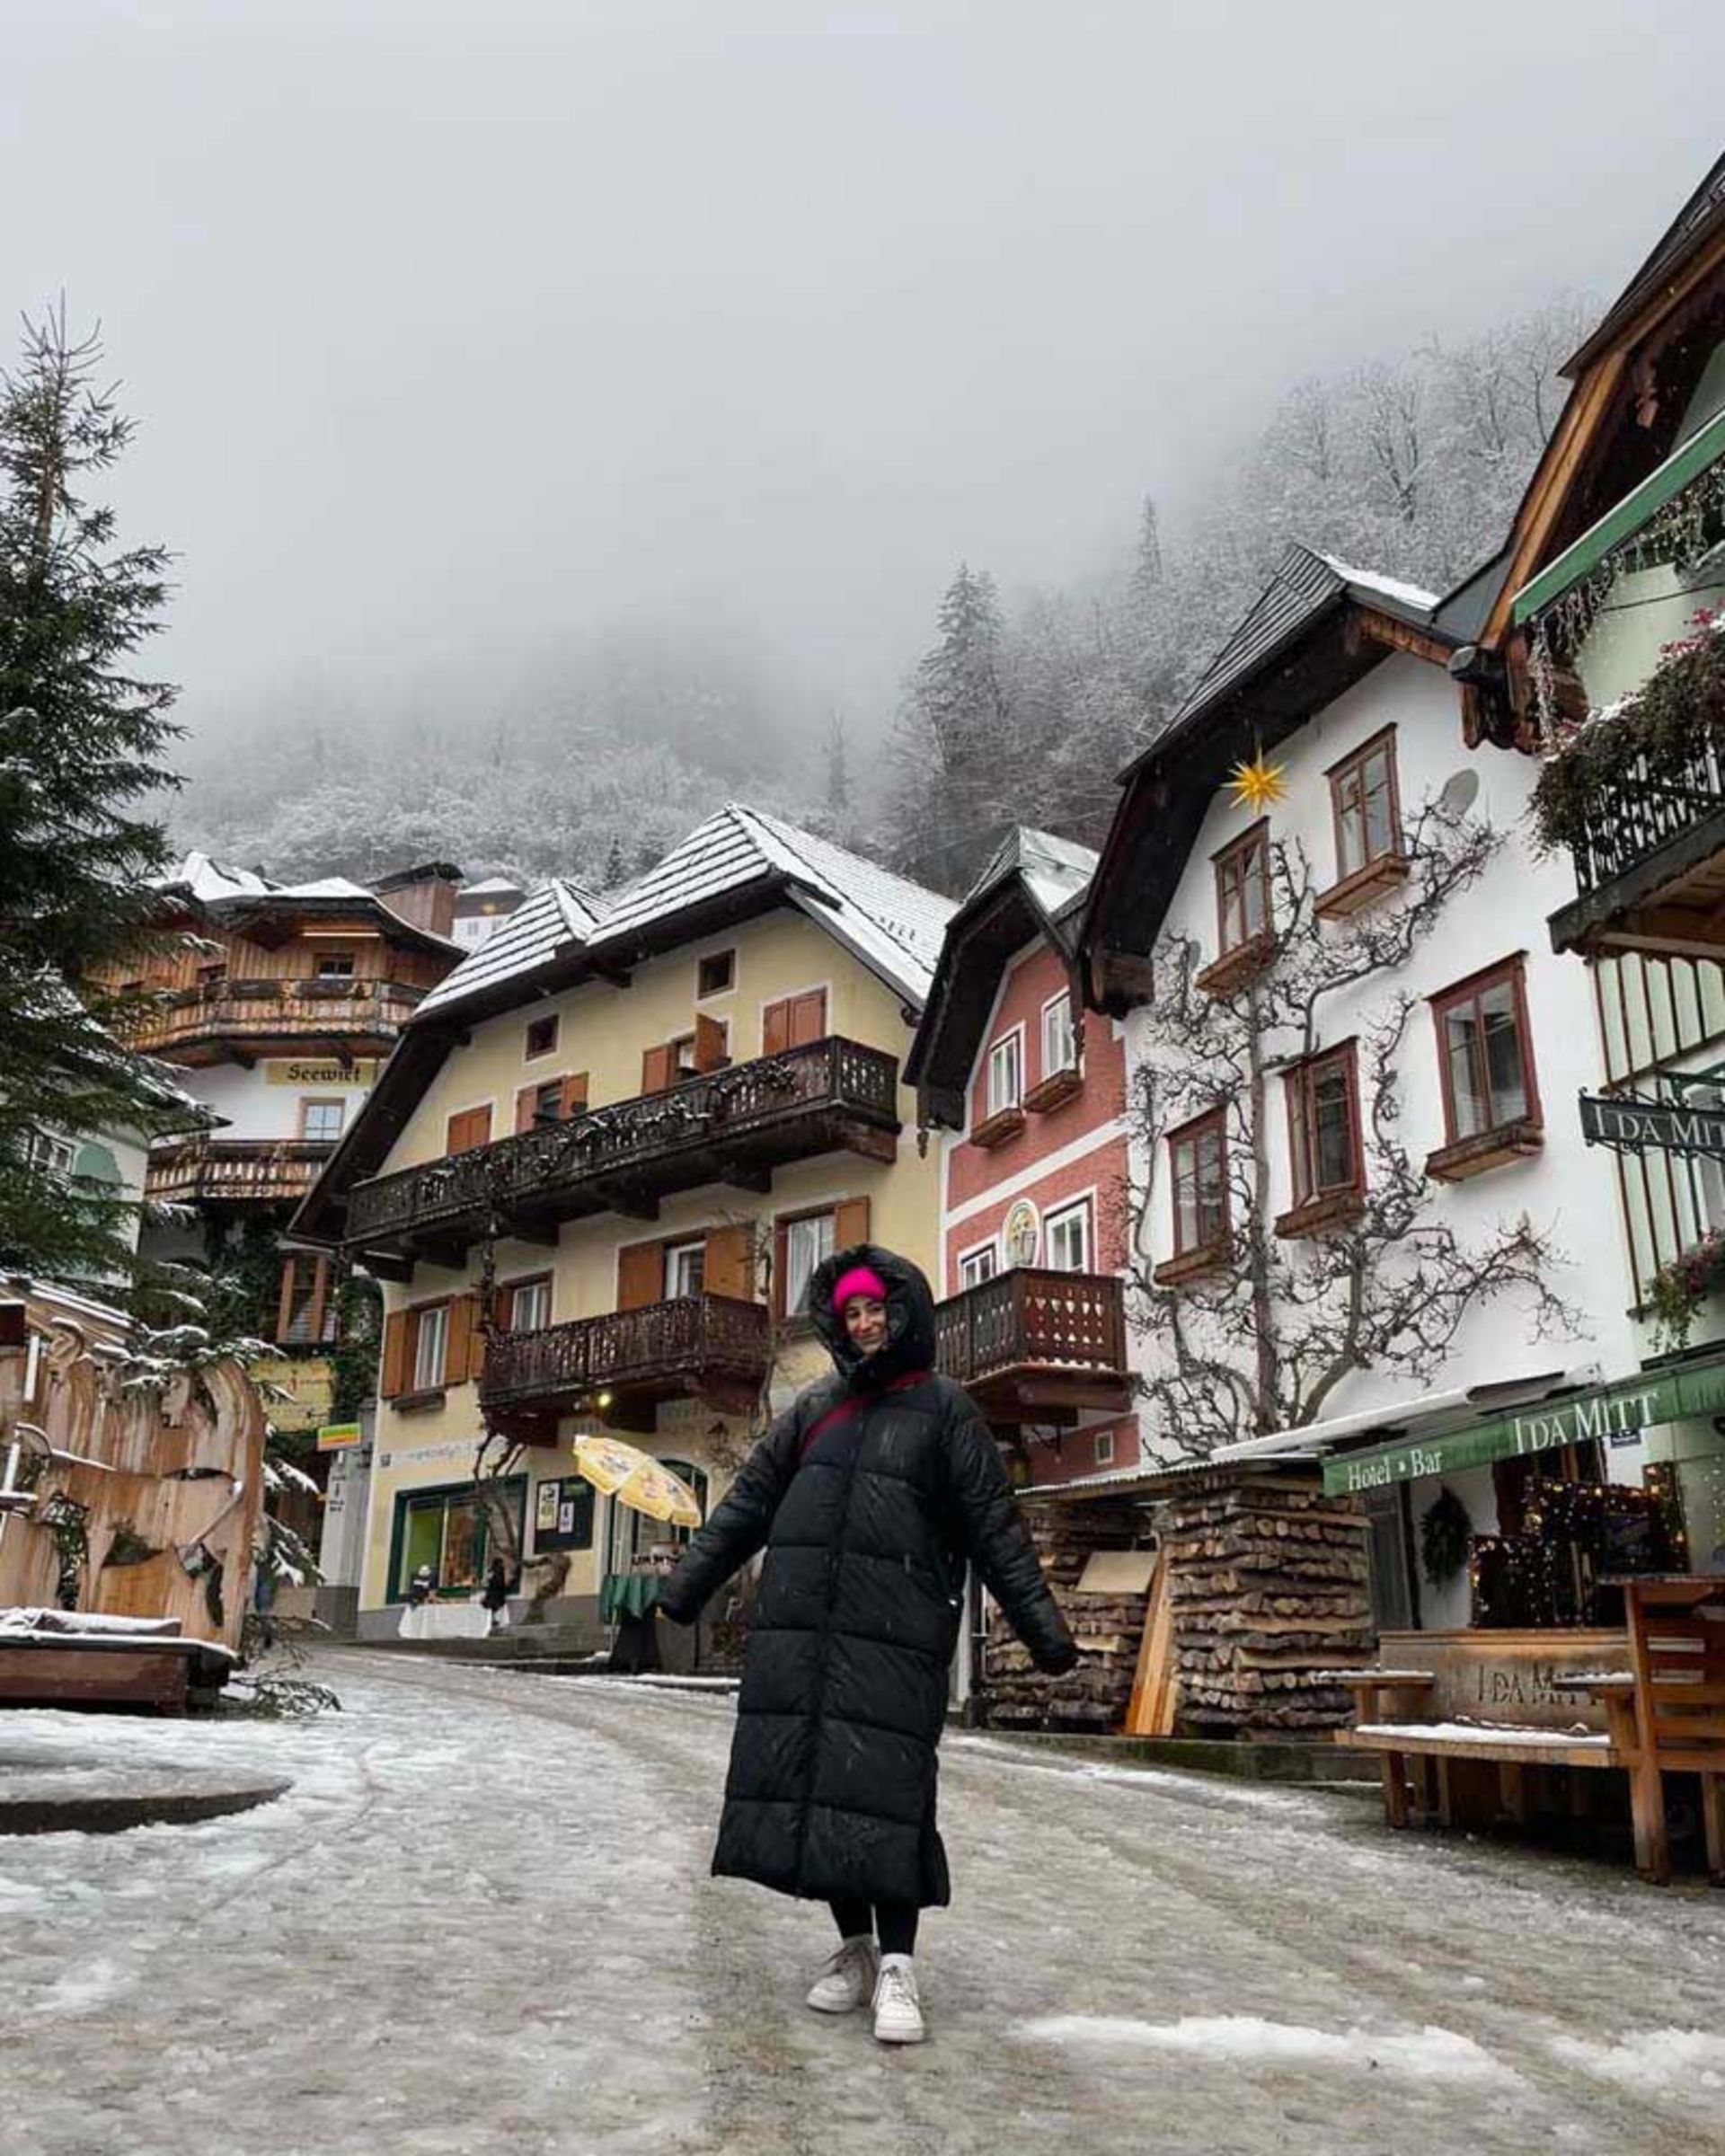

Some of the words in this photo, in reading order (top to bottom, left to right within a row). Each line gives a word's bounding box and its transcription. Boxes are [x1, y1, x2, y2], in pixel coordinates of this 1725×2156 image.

[287, 1063, 361, 1082] Seewirt
[1595, 1104, 1661, 1143] IDA
[1514, 1417, 1569, 1454] IDA
[1573, 1389, 1659, 1441] MITT
[1349, 1454, 1392, 1491] Hotel
[1410, 1448, 1443, 1478] Bar
[1478, 1664, 1524, 1704] IDA
